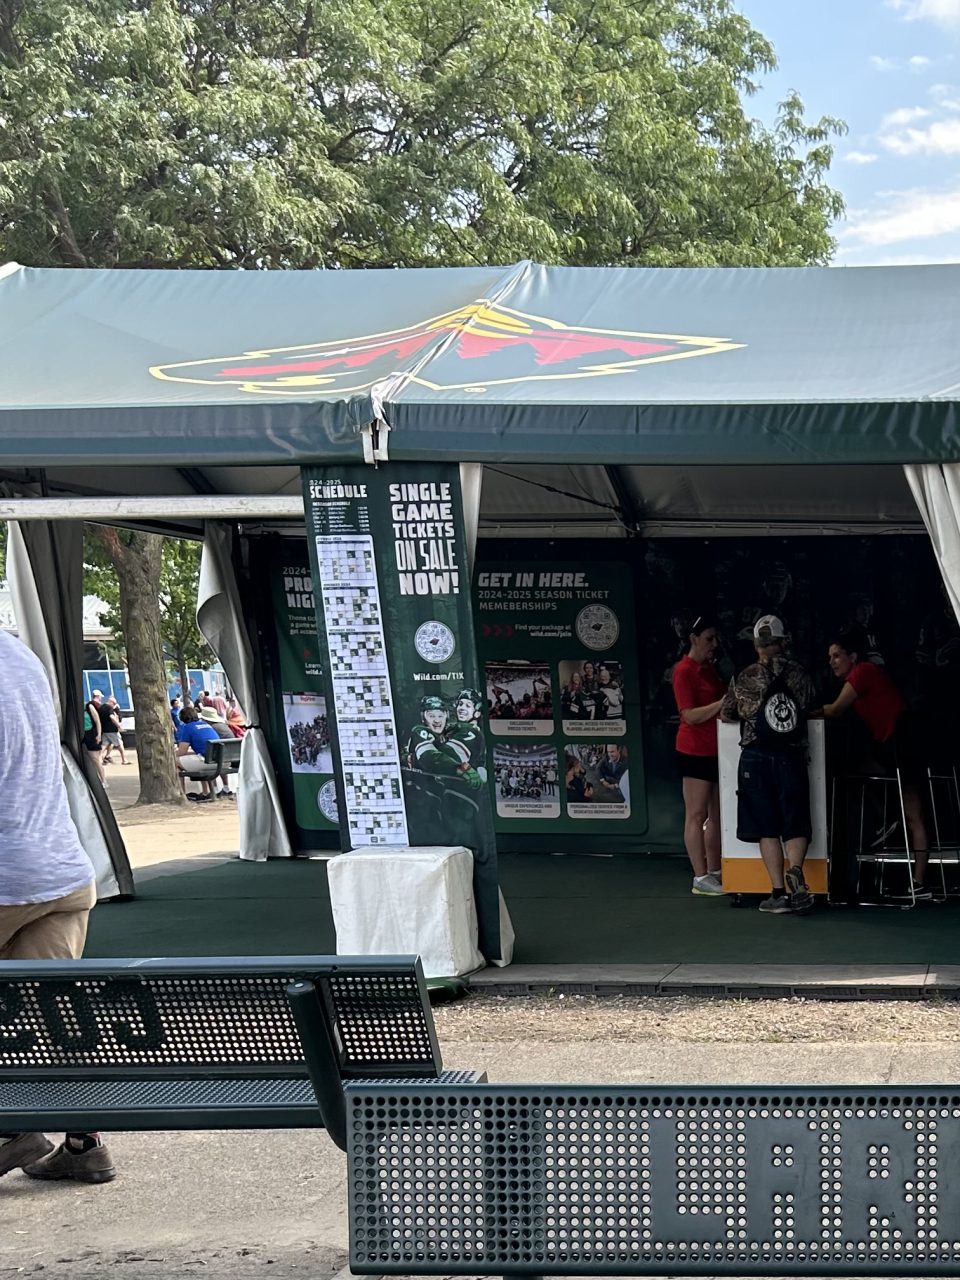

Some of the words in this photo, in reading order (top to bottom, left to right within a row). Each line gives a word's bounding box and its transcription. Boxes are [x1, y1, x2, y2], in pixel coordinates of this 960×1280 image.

[310, 484, 367, 498] SCHEDULE
[389, 483, 452, 501] SINGLE
[392, 503, 453, 521] GAME
[393, 522, 455, 538] TICKETS
[394, 540, 418, 571] ON
[419, 539, 459, 570] SALE
[399, 572, 460, 595] NOW!
[478, 573, 512, 587] GET
[515, 573, 535, 587] IN
[538, 573, 589, 587] HERE.
[478, 590, 531, 599] 2024-2025
[534, 590, 573, 599] SEASON
[576, 590, 609, 598] TICKET
[479, 602, 557, 611] MEMEBERSHIPS
[413, 672, 464, 681] Wild.com/TIX
